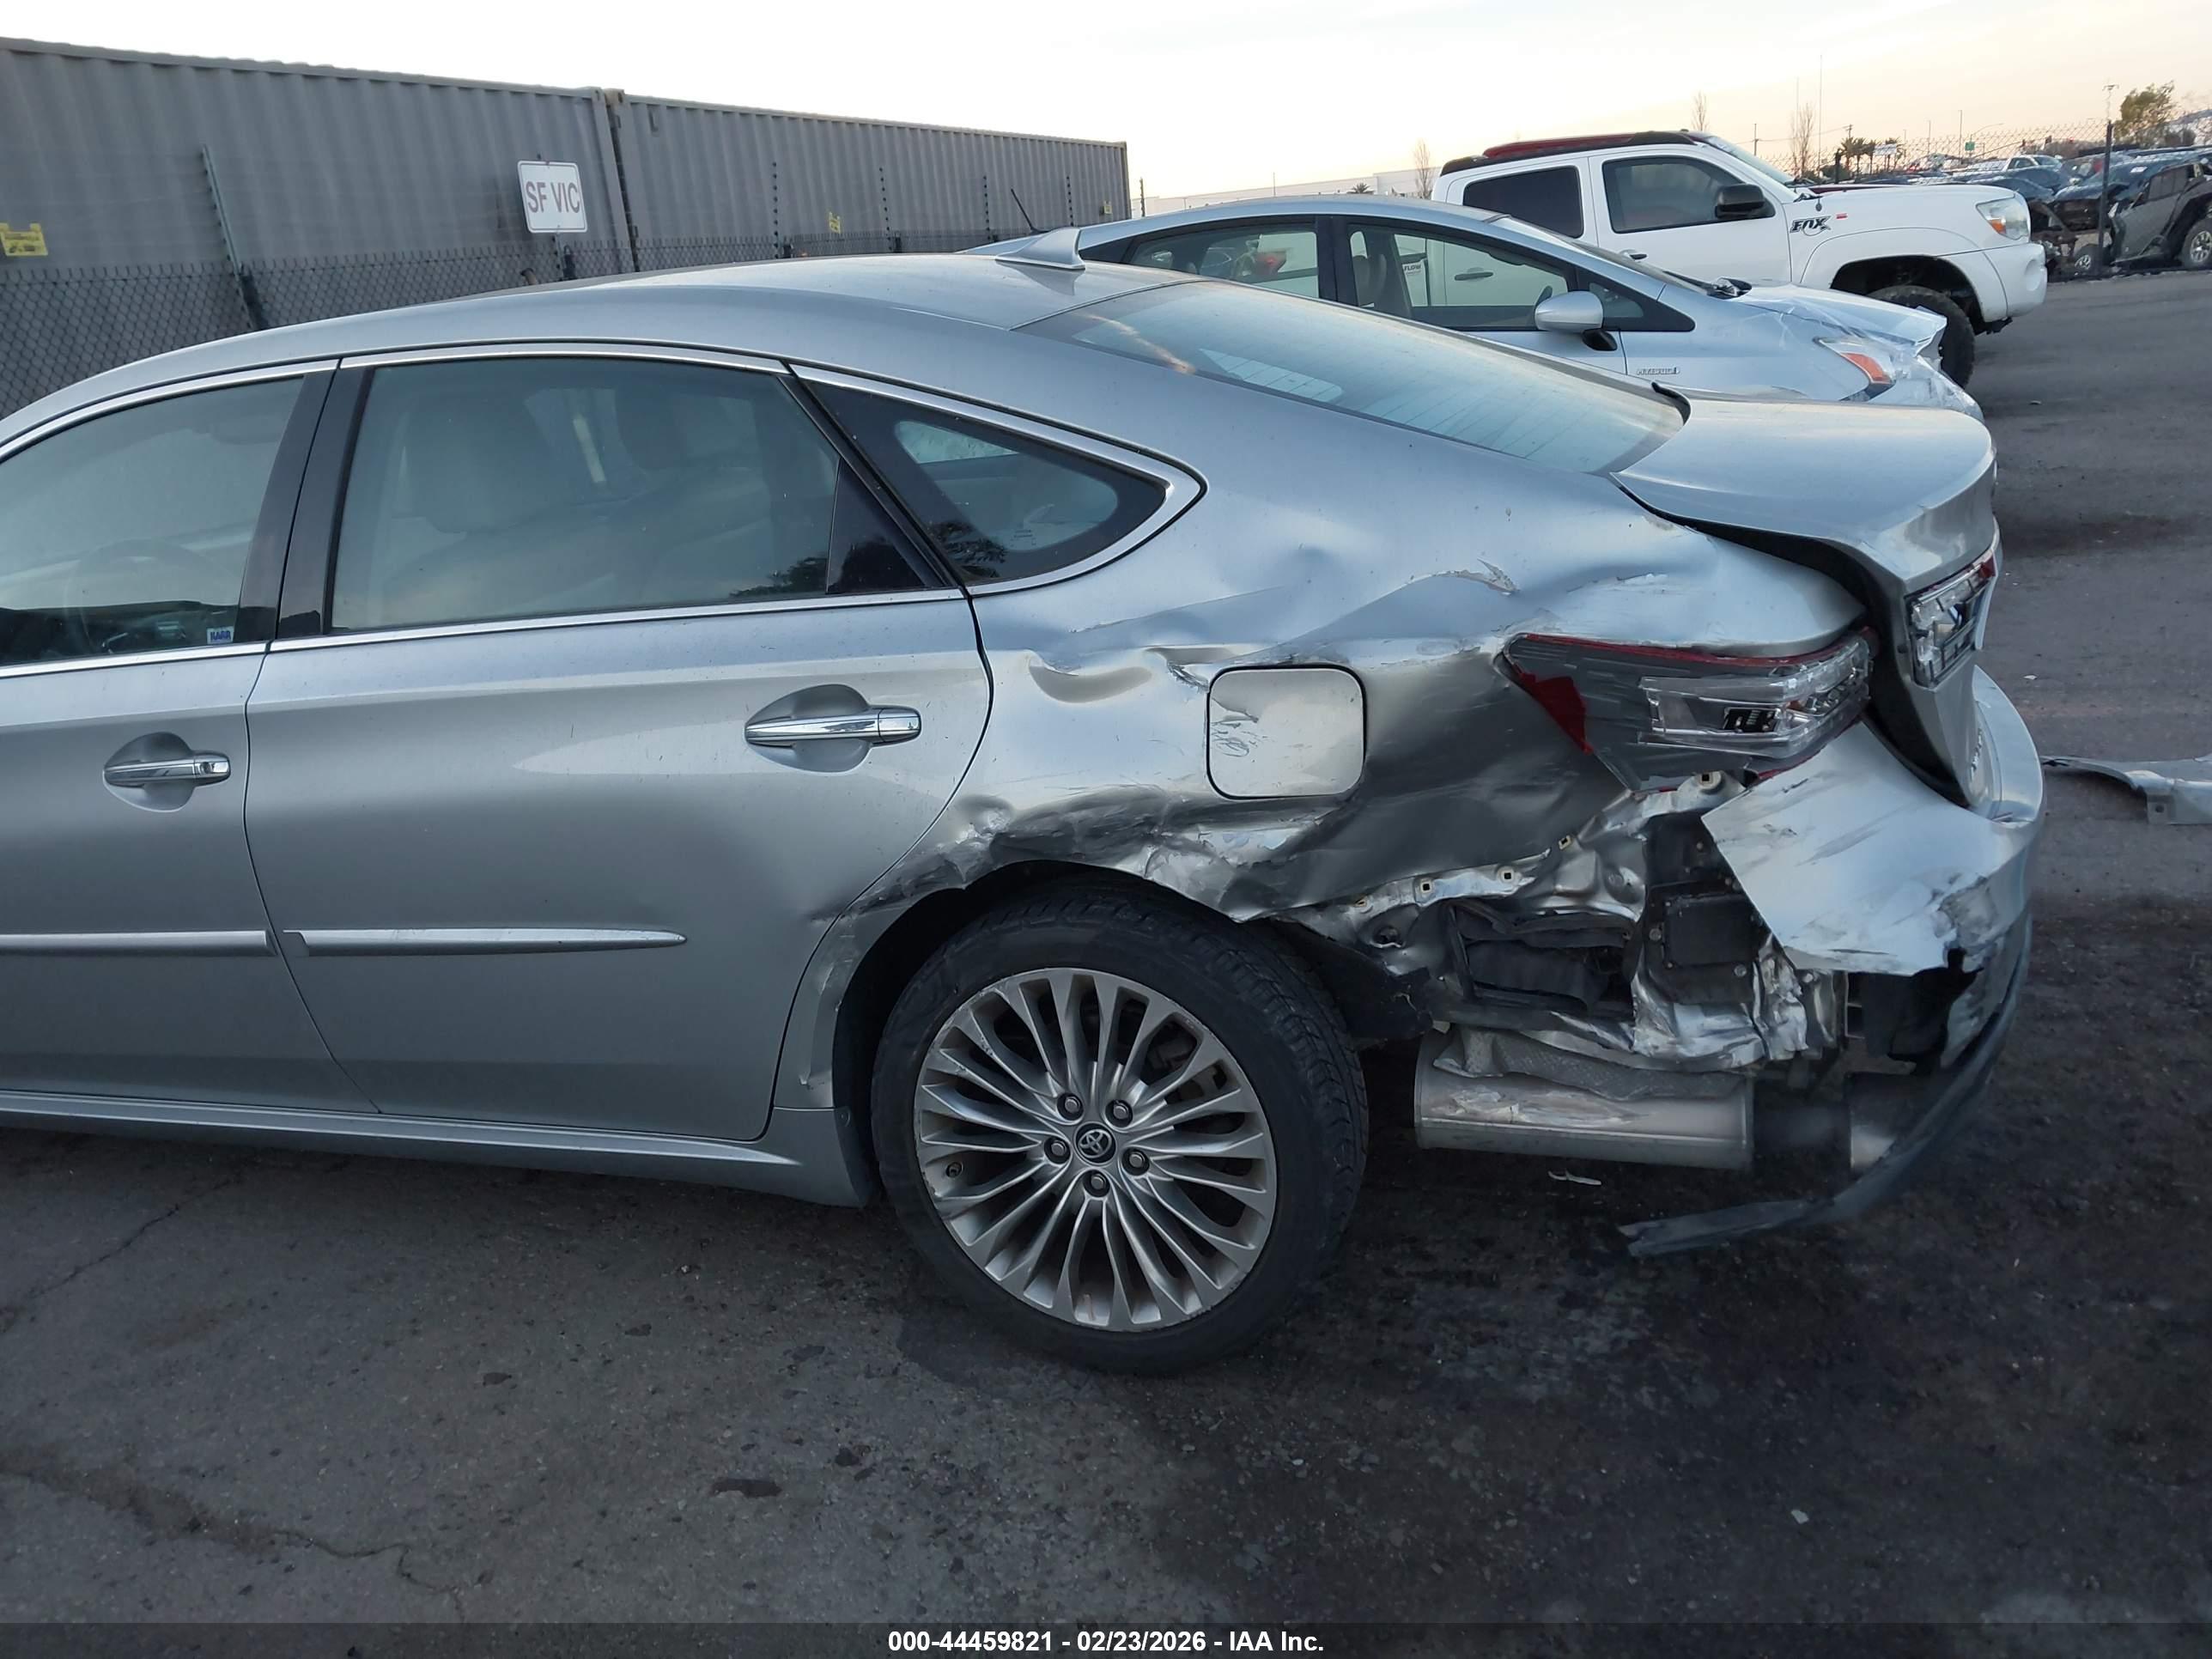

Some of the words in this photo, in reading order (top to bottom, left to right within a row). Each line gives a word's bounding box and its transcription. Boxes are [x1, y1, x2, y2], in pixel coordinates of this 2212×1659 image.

[526, 180, 547, 214] SF
[550, 181, 580, 214] VIC
[1790, 216, 1832, 236] FOX
